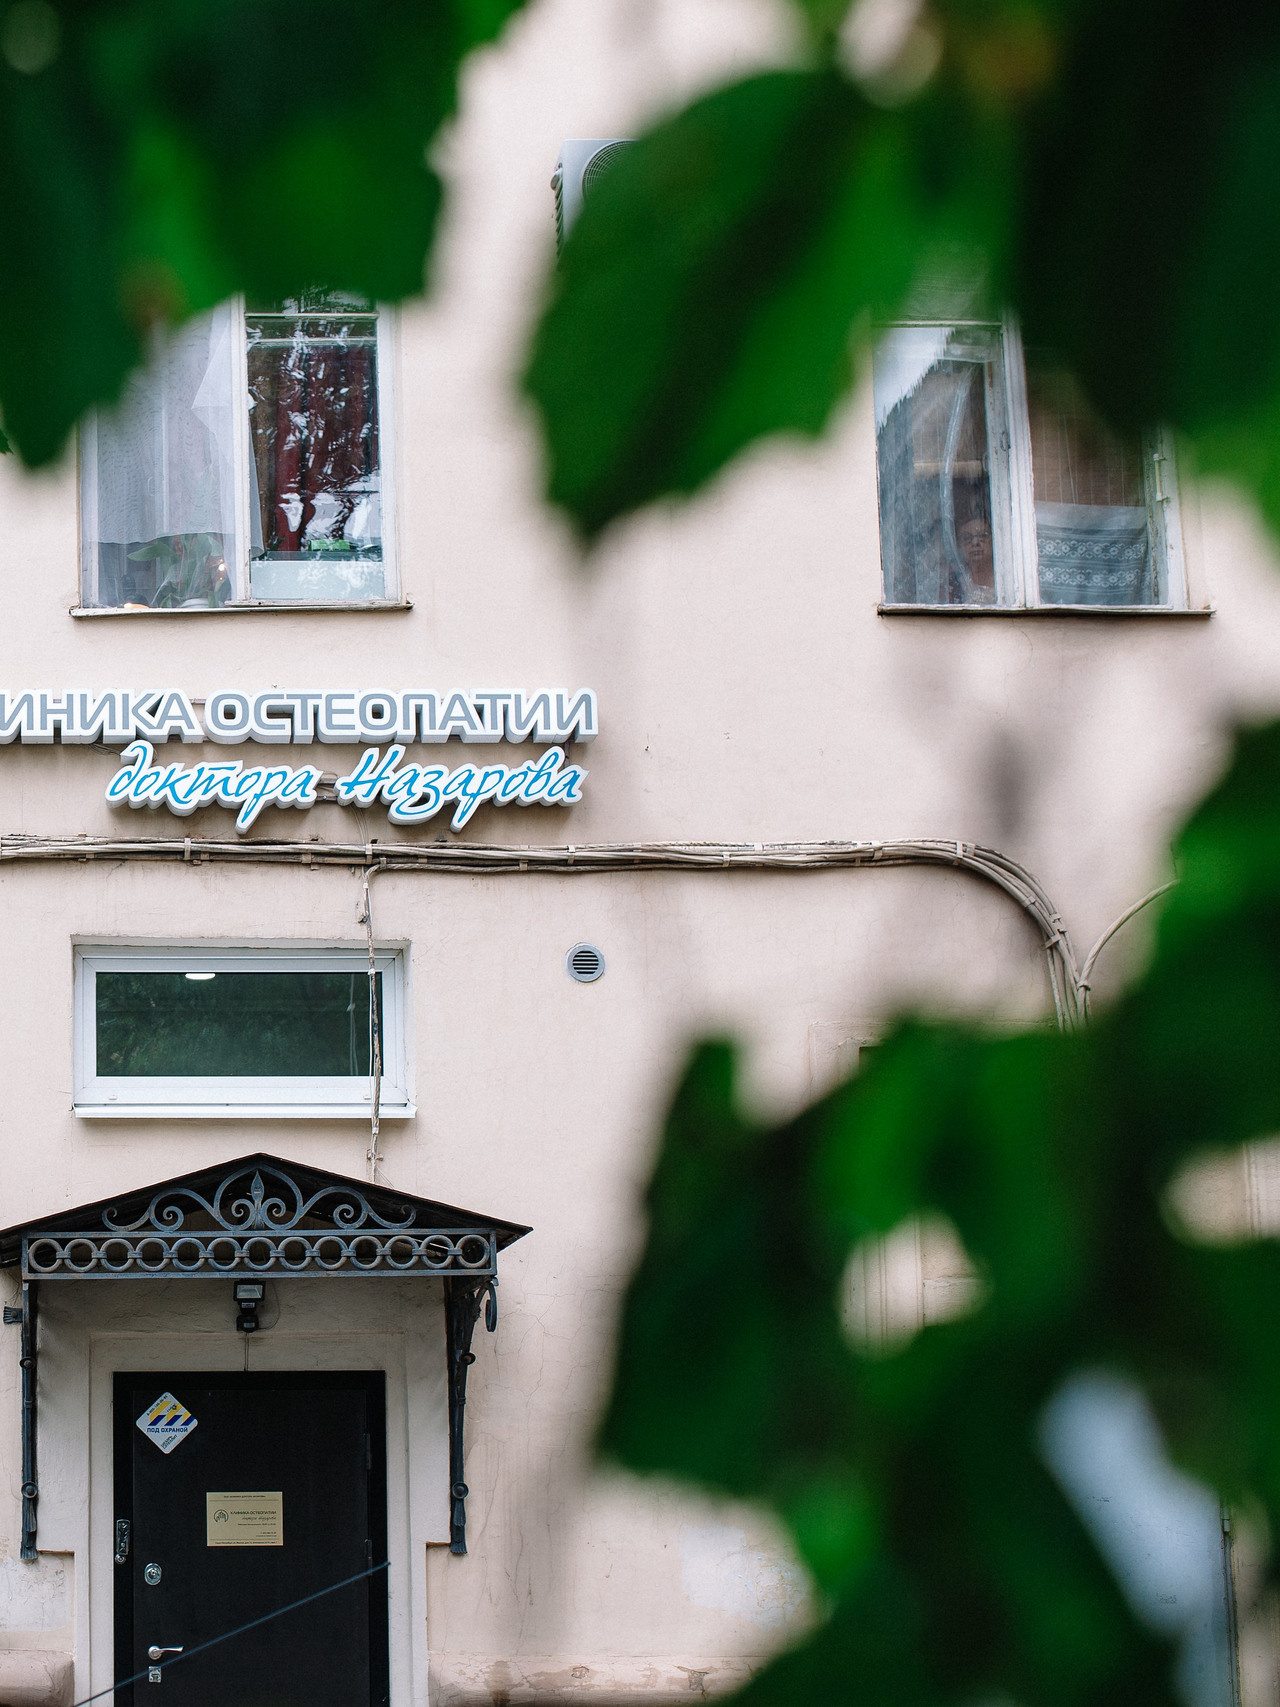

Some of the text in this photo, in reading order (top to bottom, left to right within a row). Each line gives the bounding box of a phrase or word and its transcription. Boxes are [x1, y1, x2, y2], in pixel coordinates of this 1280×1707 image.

[209, 691, 594, 735] ОСТЕОПАТИИ
[108, 743, 582, 825] доктора Назарова
